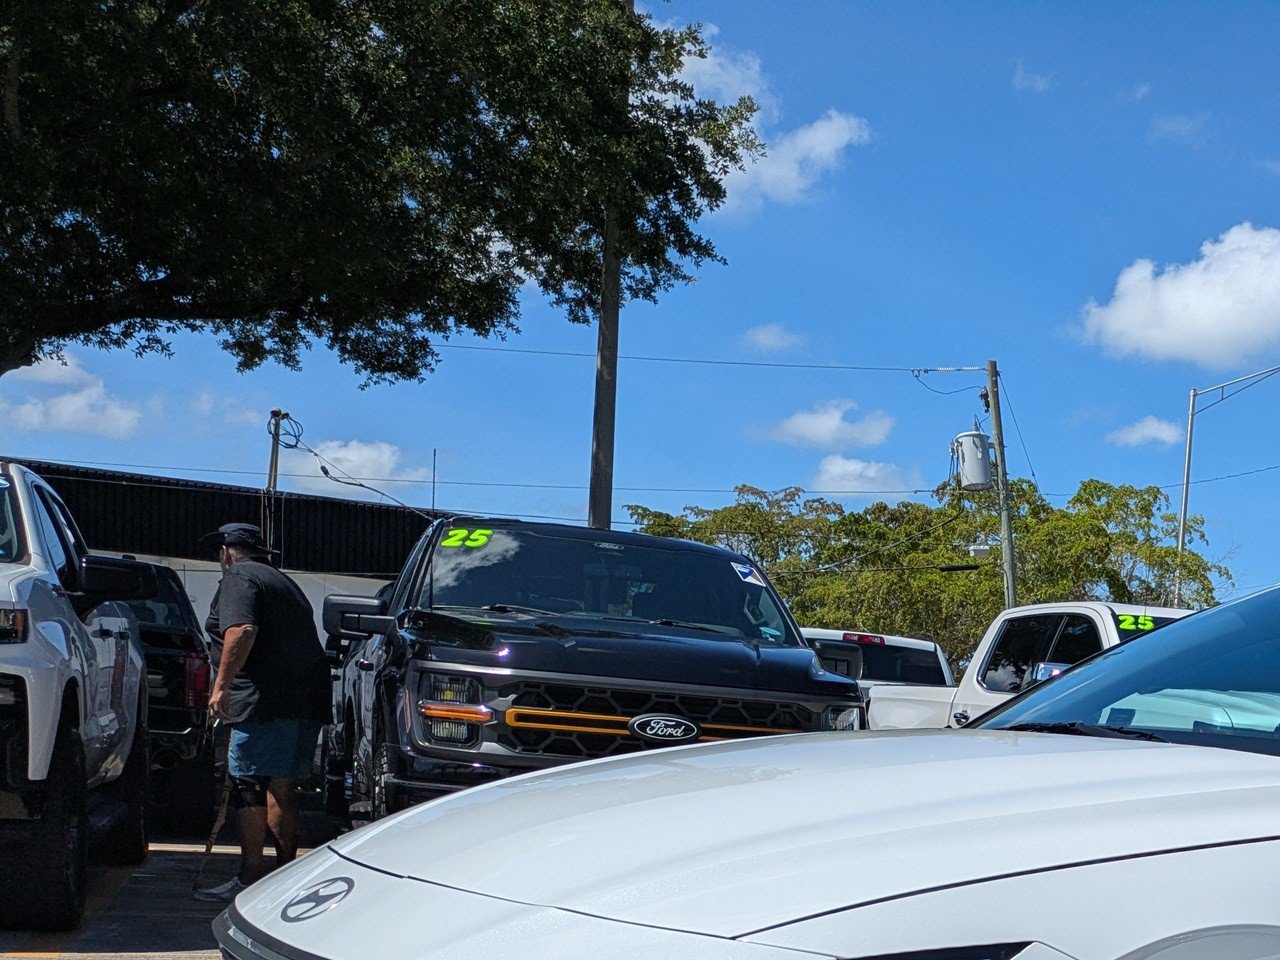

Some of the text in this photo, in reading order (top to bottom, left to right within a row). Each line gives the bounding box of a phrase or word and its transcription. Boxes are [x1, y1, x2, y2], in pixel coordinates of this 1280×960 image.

[441, 528, 494, 548] 25
[1118, 615, 1155, 631] 25
[646, 719, 686, 737] Ford
